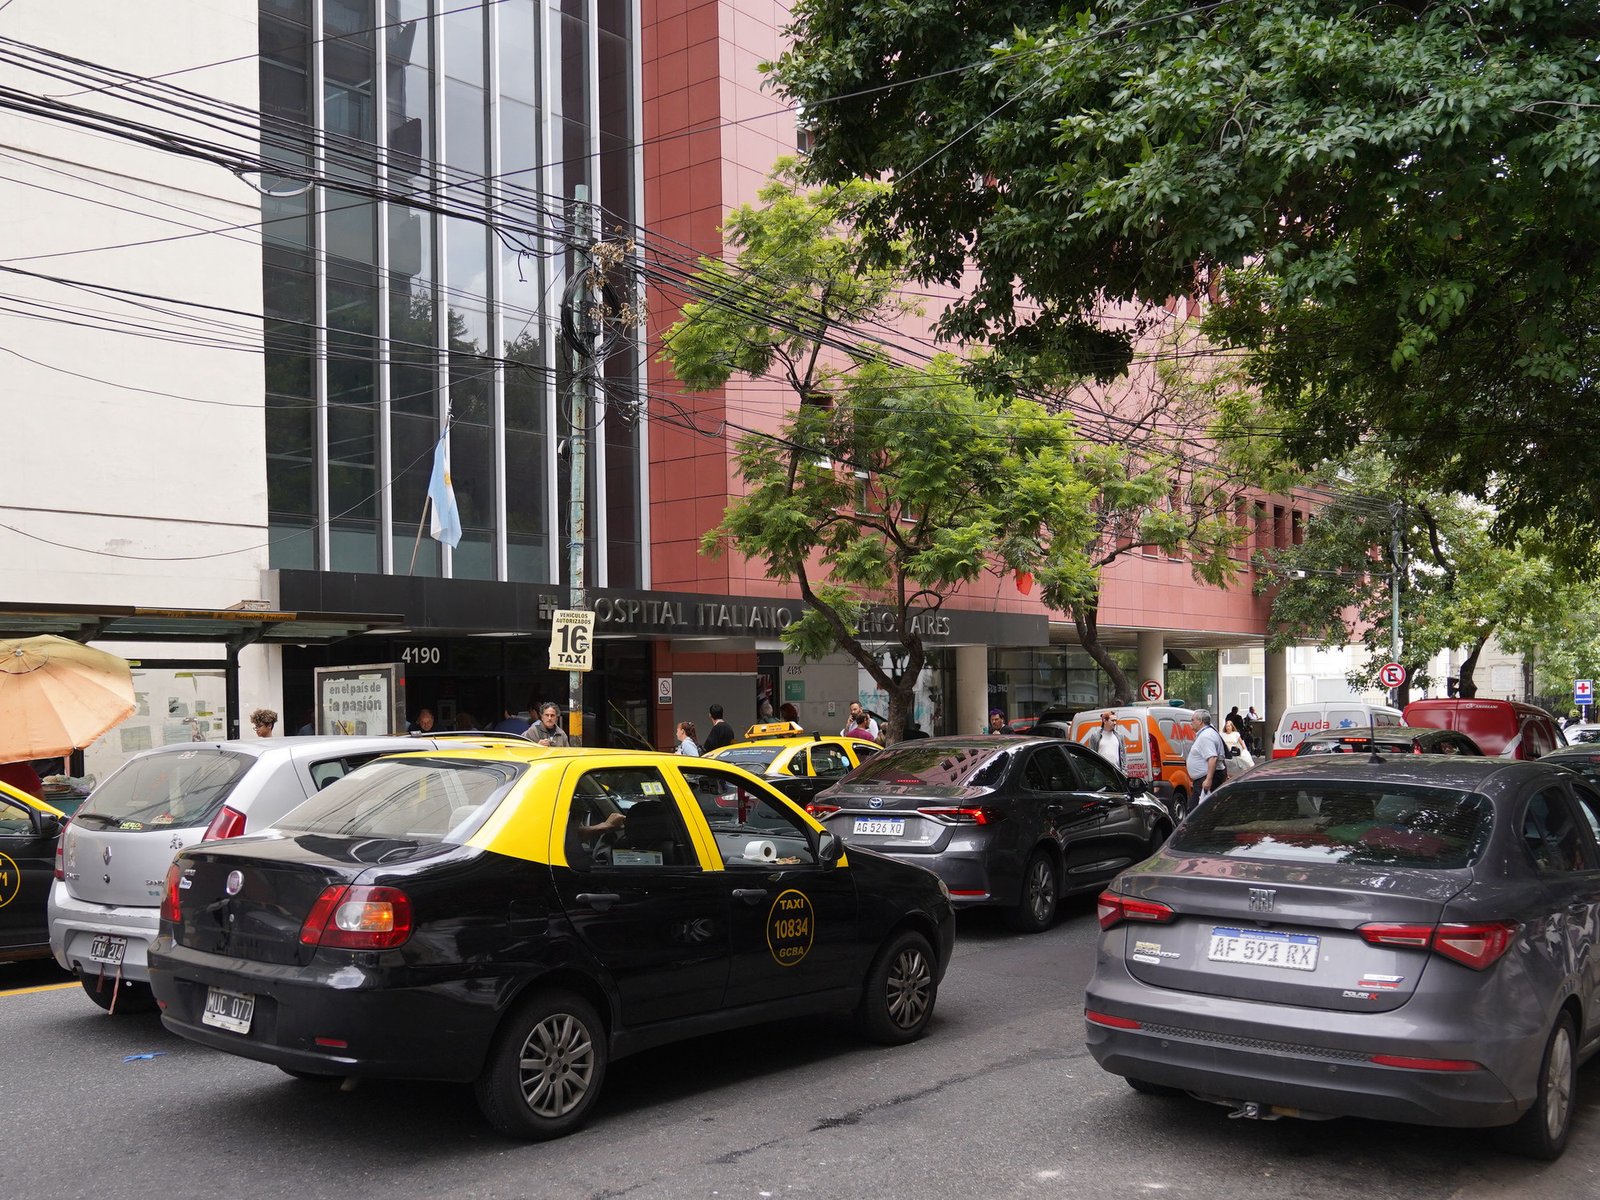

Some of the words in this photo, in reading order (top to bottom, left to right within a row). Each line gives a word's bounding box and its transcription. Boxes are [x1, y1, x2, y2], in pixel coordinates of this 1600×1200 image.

[588, 597, 688, 625] OSPITAL
[698, 603, 792, 628] ITALIANO
[910, 615, 951, 636] AIRES
[557, 624, 588, 654] 16
[401, 647, 440, 664] 4190
[557, 653, 586, 664] TAXI
[329, 685, 341, 695] en
[341, 683, 350, 695] el
[350, 682, 369, 696] país
[370, 682, 382, 693] de
[342, 696, 382, 714] pasión
[1290, 720, 1330, 733] Ayuda
[1282, 734, 1293, 743] 110
[856, 823, 867, 832] AG
[869, 823, 887, 833] 526
[889, 824, 902, 833] XQ
[779, 899, 804, 910] TAXI
[1248, 887, 1277, 913] FIAT
[774, 917, 809, 939] 10834
[107, 943, 125, 960] 214
[779, 946, 804, 957] GCBA
[1213, 937, 1239, 957] AF
[1243, 940, 1280, 962] 591
[1285, 945, 1312, 965] RX
[206, 992, 228, 1015] MUC
[231, 998, 252, 1020] 077
